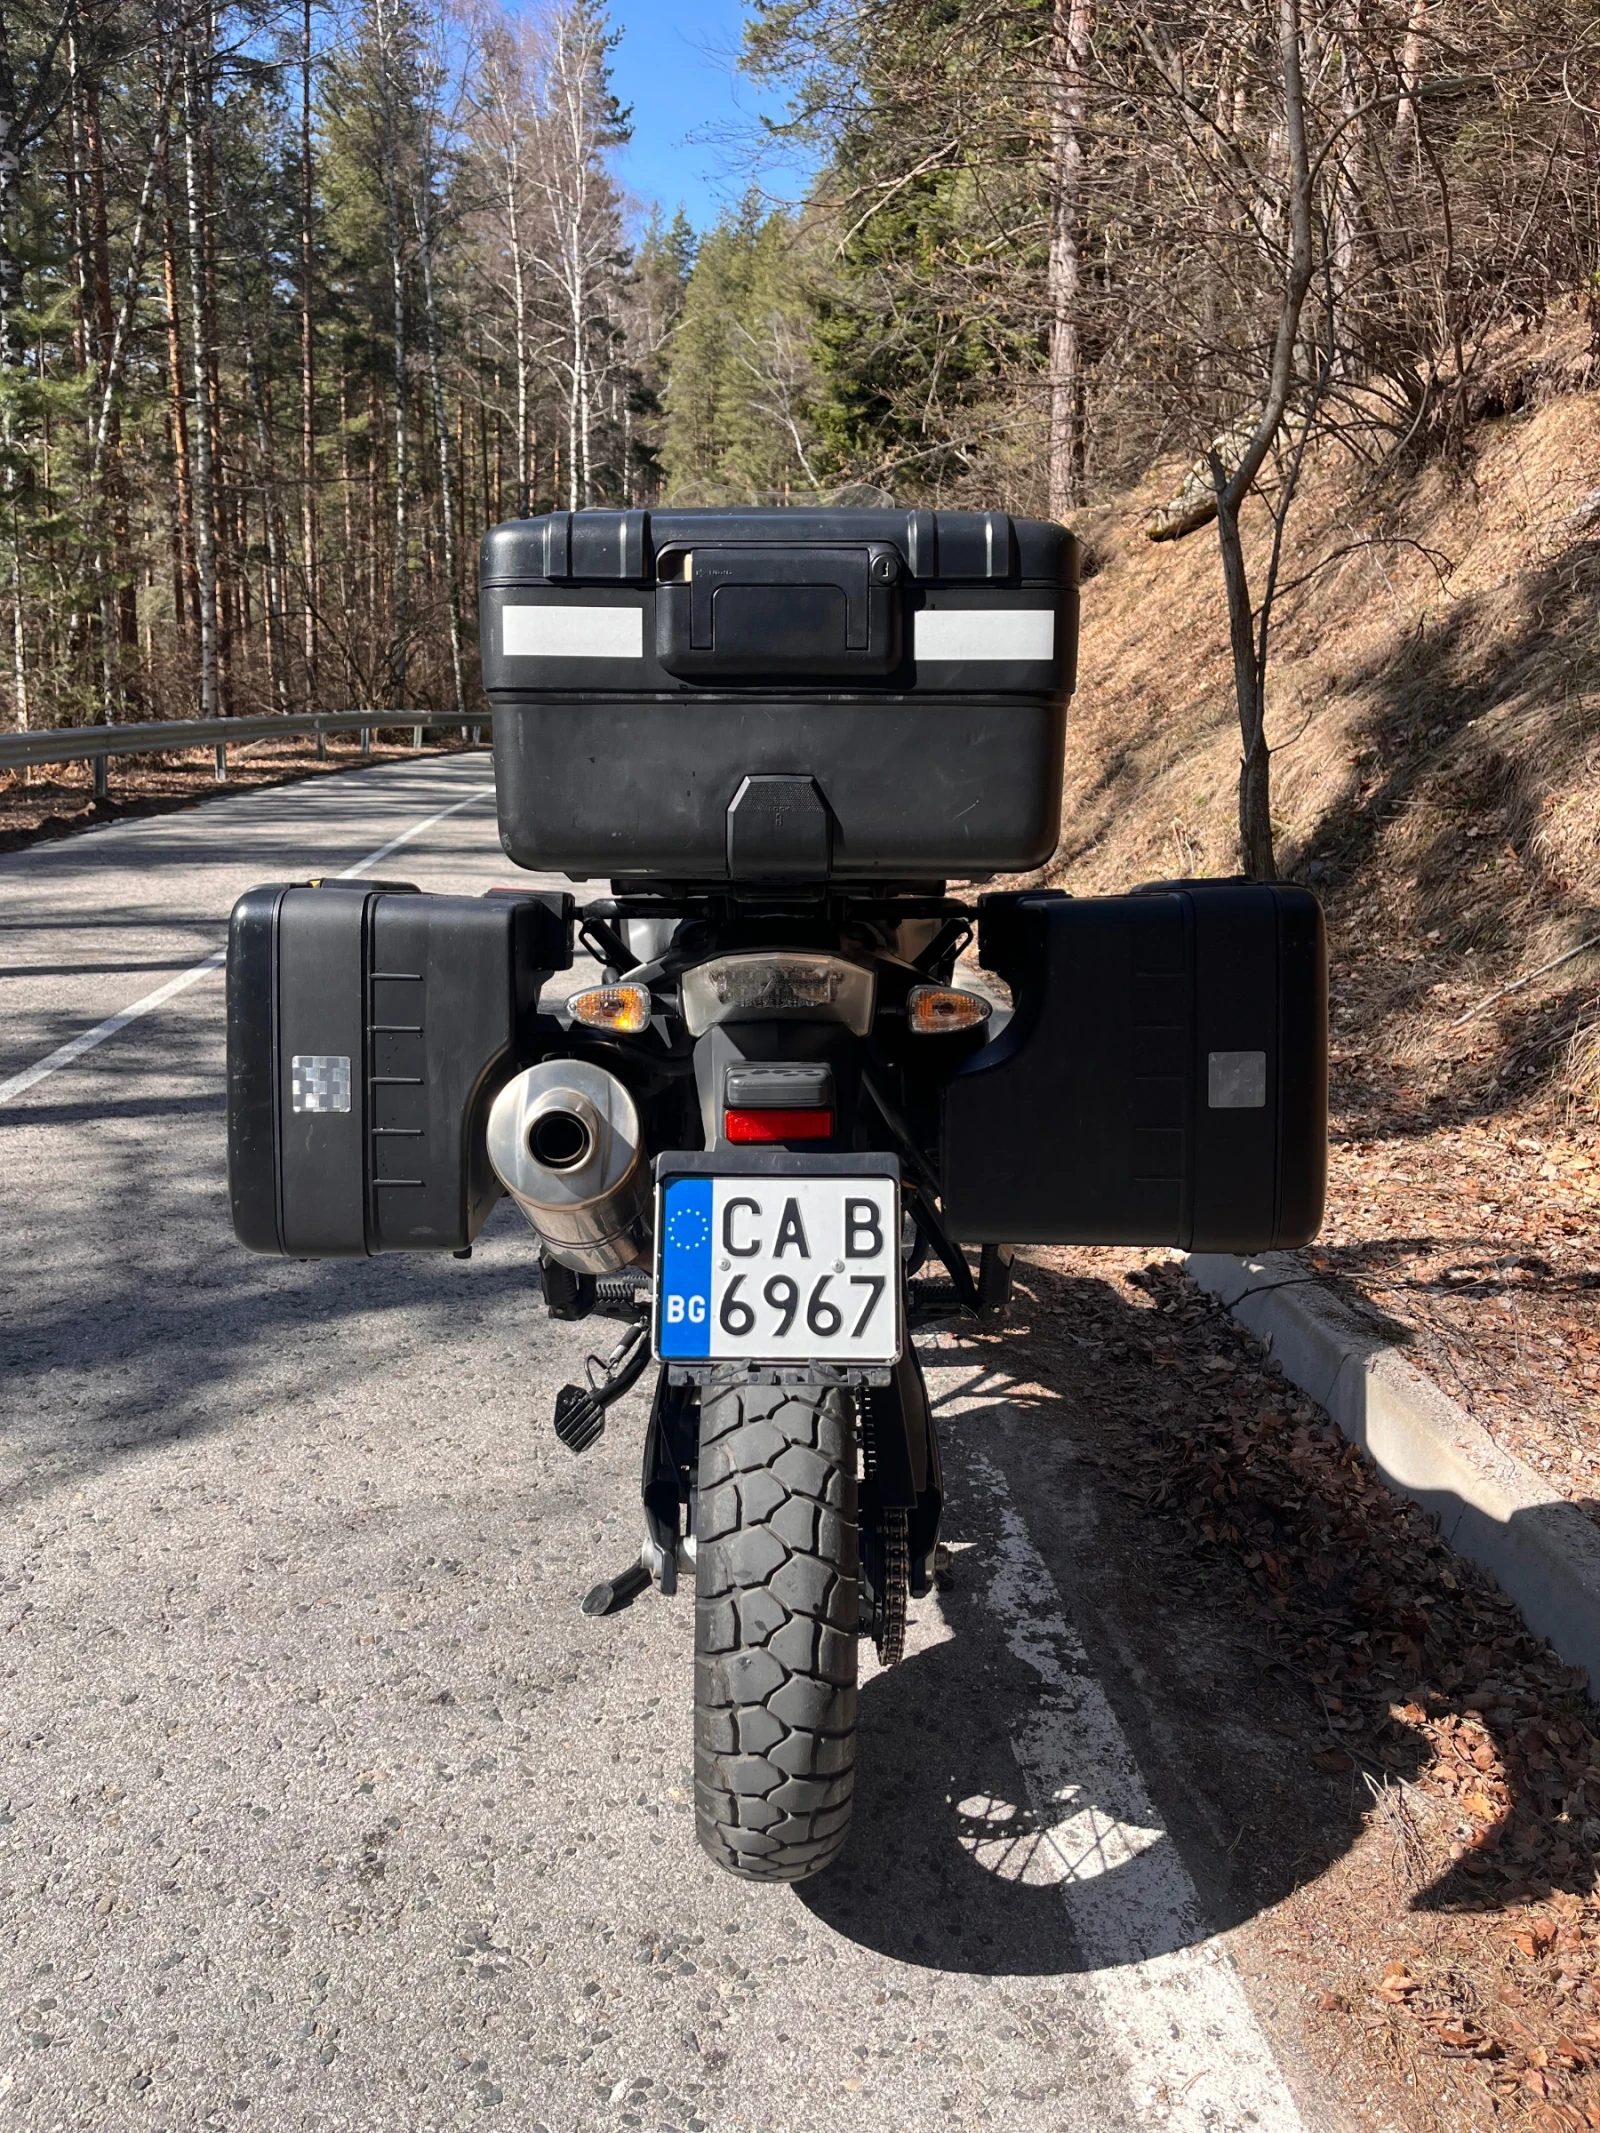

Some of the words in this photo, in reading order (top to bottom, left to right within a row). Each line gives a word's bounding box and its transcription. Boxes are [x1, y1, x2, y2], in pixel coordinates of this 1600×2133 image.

[722, 1196, 811, 1258] CA
[844, 1197, 884, 1259] B
[667, 1294, 706, 1324] BG
[719, 1273, 886, 1338] 6967
